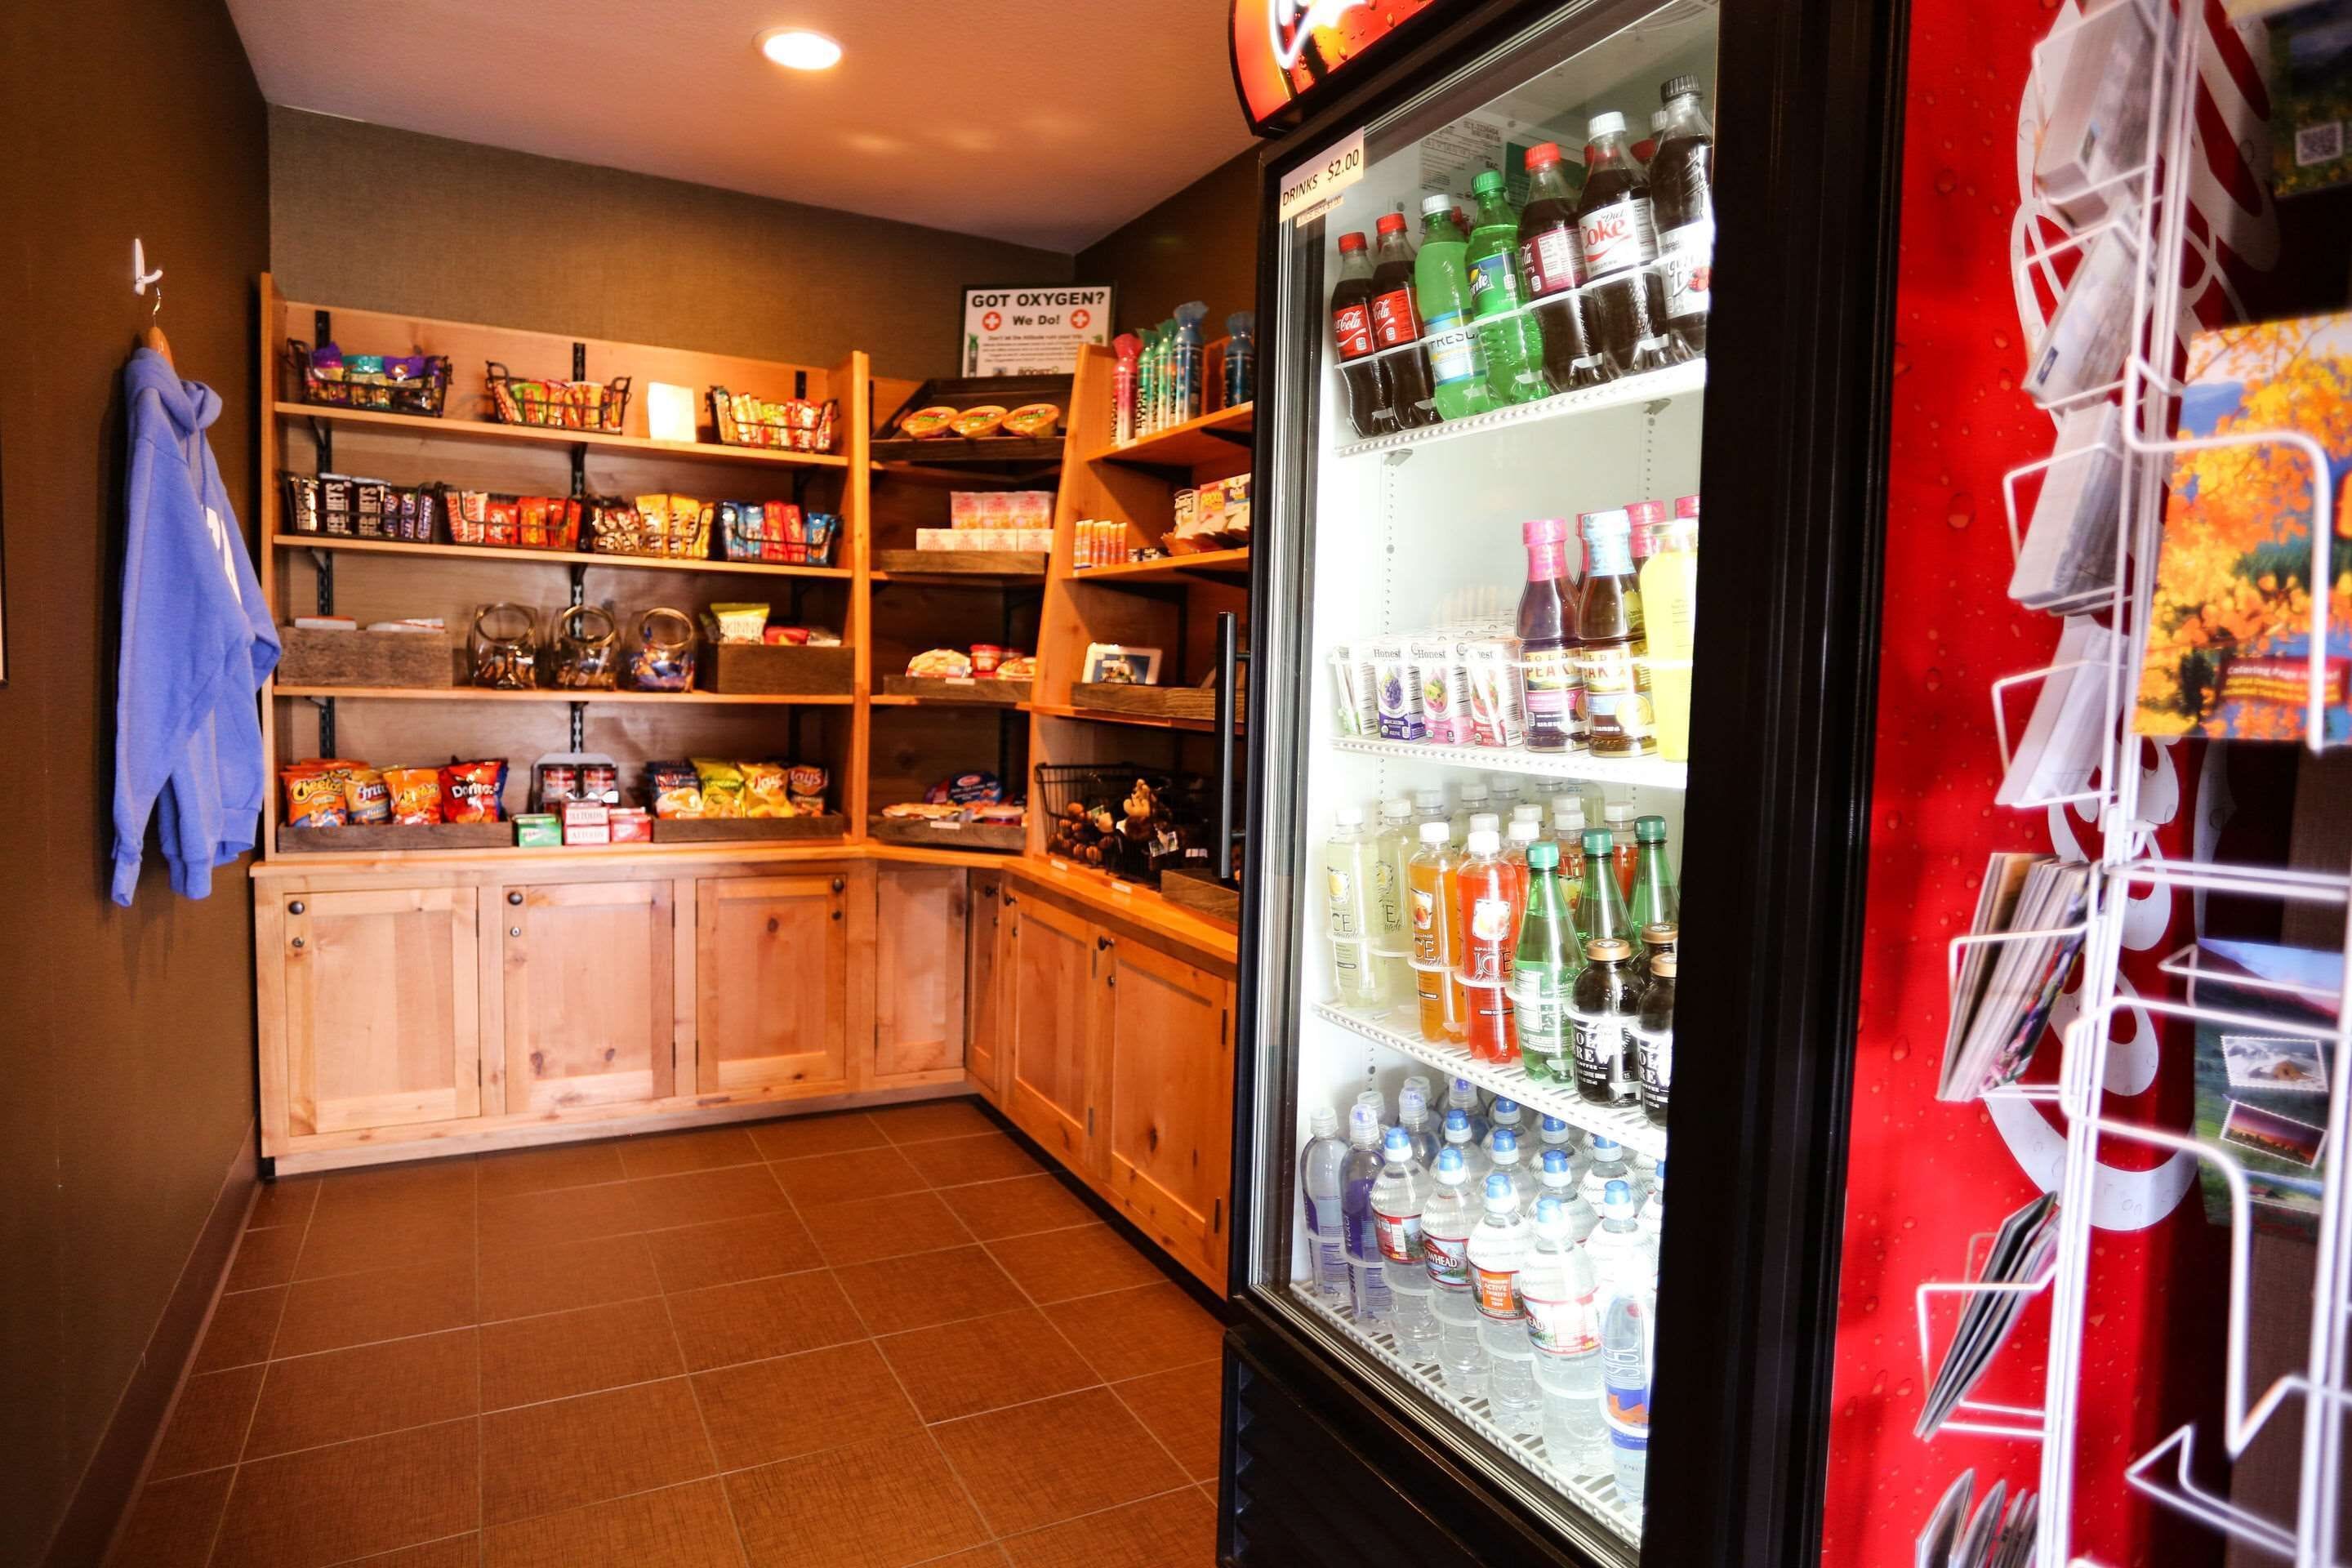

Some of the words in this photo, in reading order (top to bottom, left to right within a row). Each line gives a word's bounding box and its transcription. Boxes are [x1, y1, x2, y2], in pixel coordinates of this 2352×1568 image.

[1282, 173, 1318, 207] DRINKS
[1327, 149, 1359, 183] $2.00
[972, 294, 1010, 308] GOT
[1017, 292, 1105, 306] OXYGEN?
[1013, 315, 1033, 326] We
[1038, 315, 1061, 325] Do!
[1374, 648, 1401, 658] Honest
[1418, 649, 1446, 659] Honest
[2227, 666, 2270, 676] Coloring
[1484, 1283, 1508, 1292] ACTIVE
